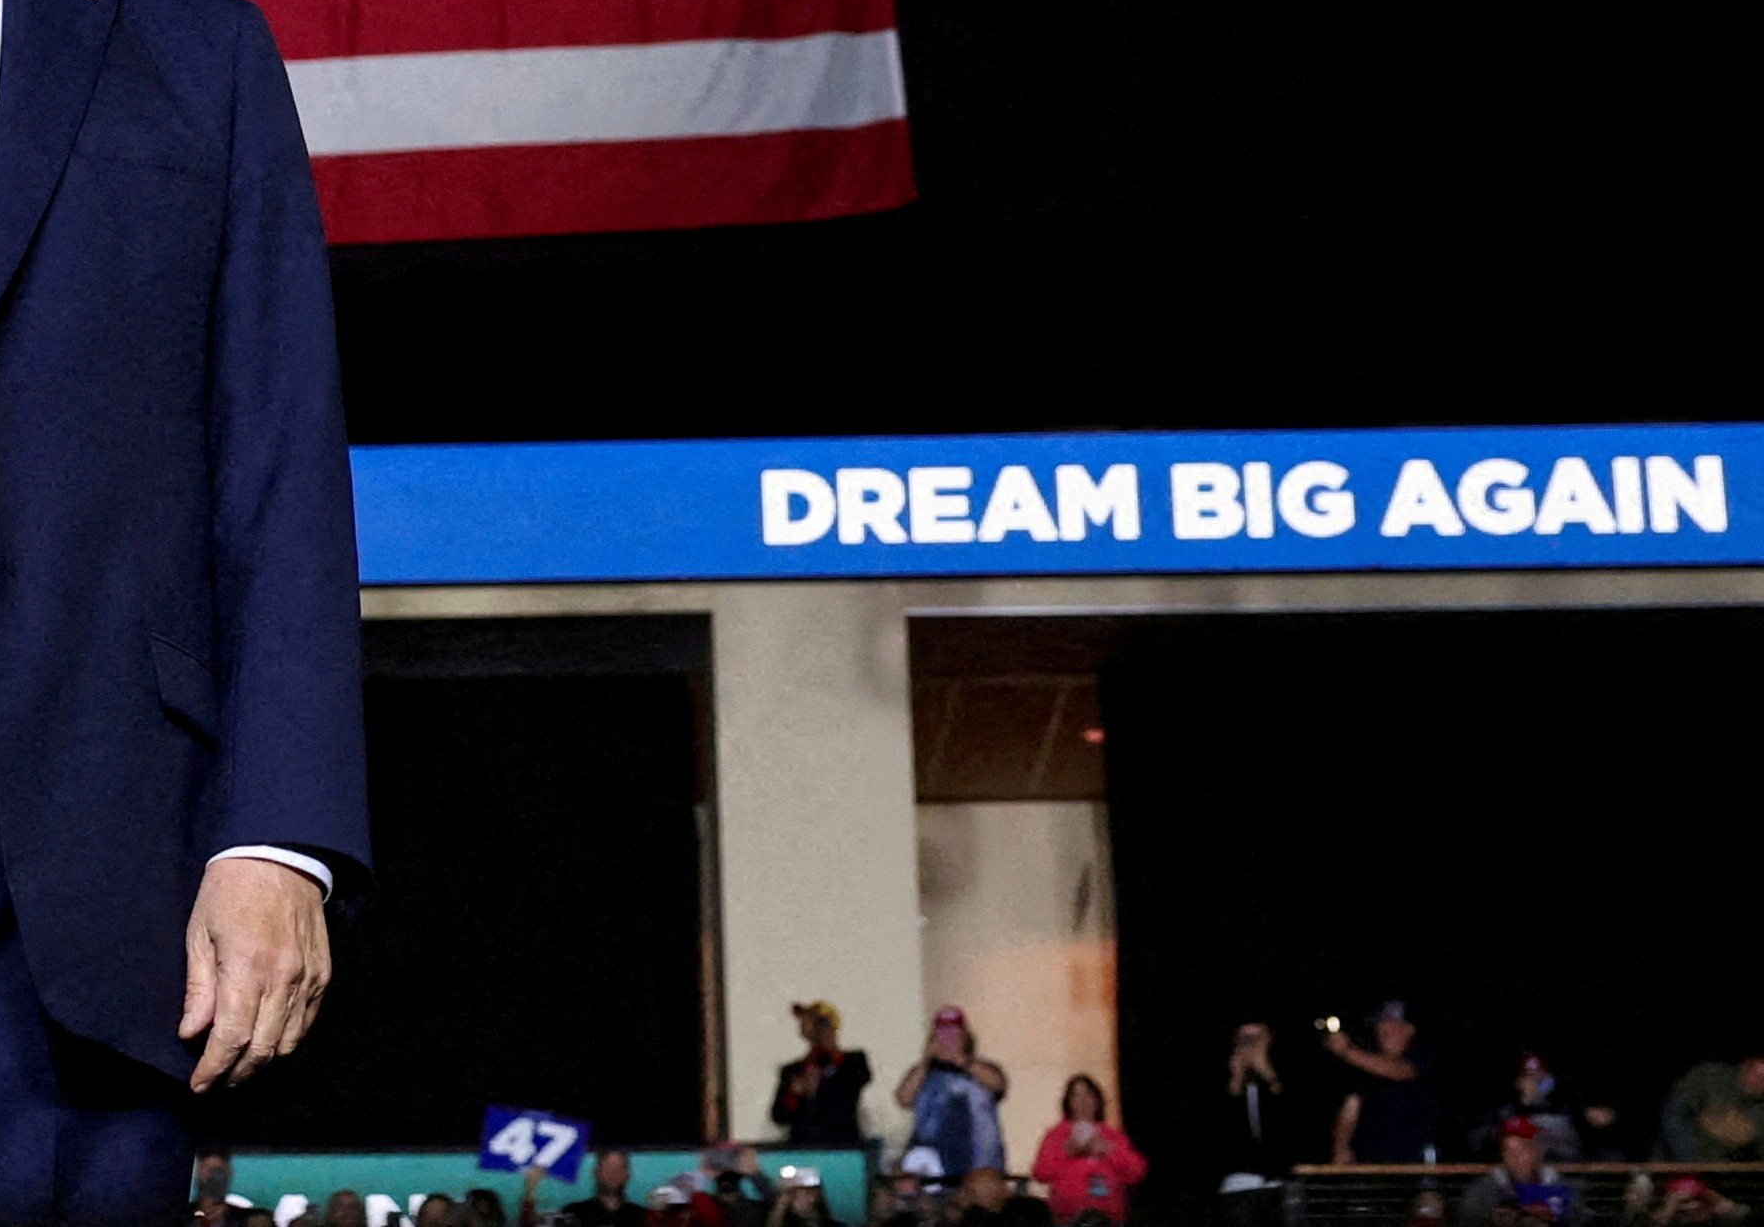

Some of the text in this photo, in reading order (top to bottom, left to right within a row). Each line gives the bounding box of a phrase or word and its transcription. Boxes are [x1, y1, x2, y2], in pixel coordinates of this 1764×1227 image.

[761, 455, 1727, 545] DREAM BIG AGAIN
[489, 1118, 578, 1167] 47
